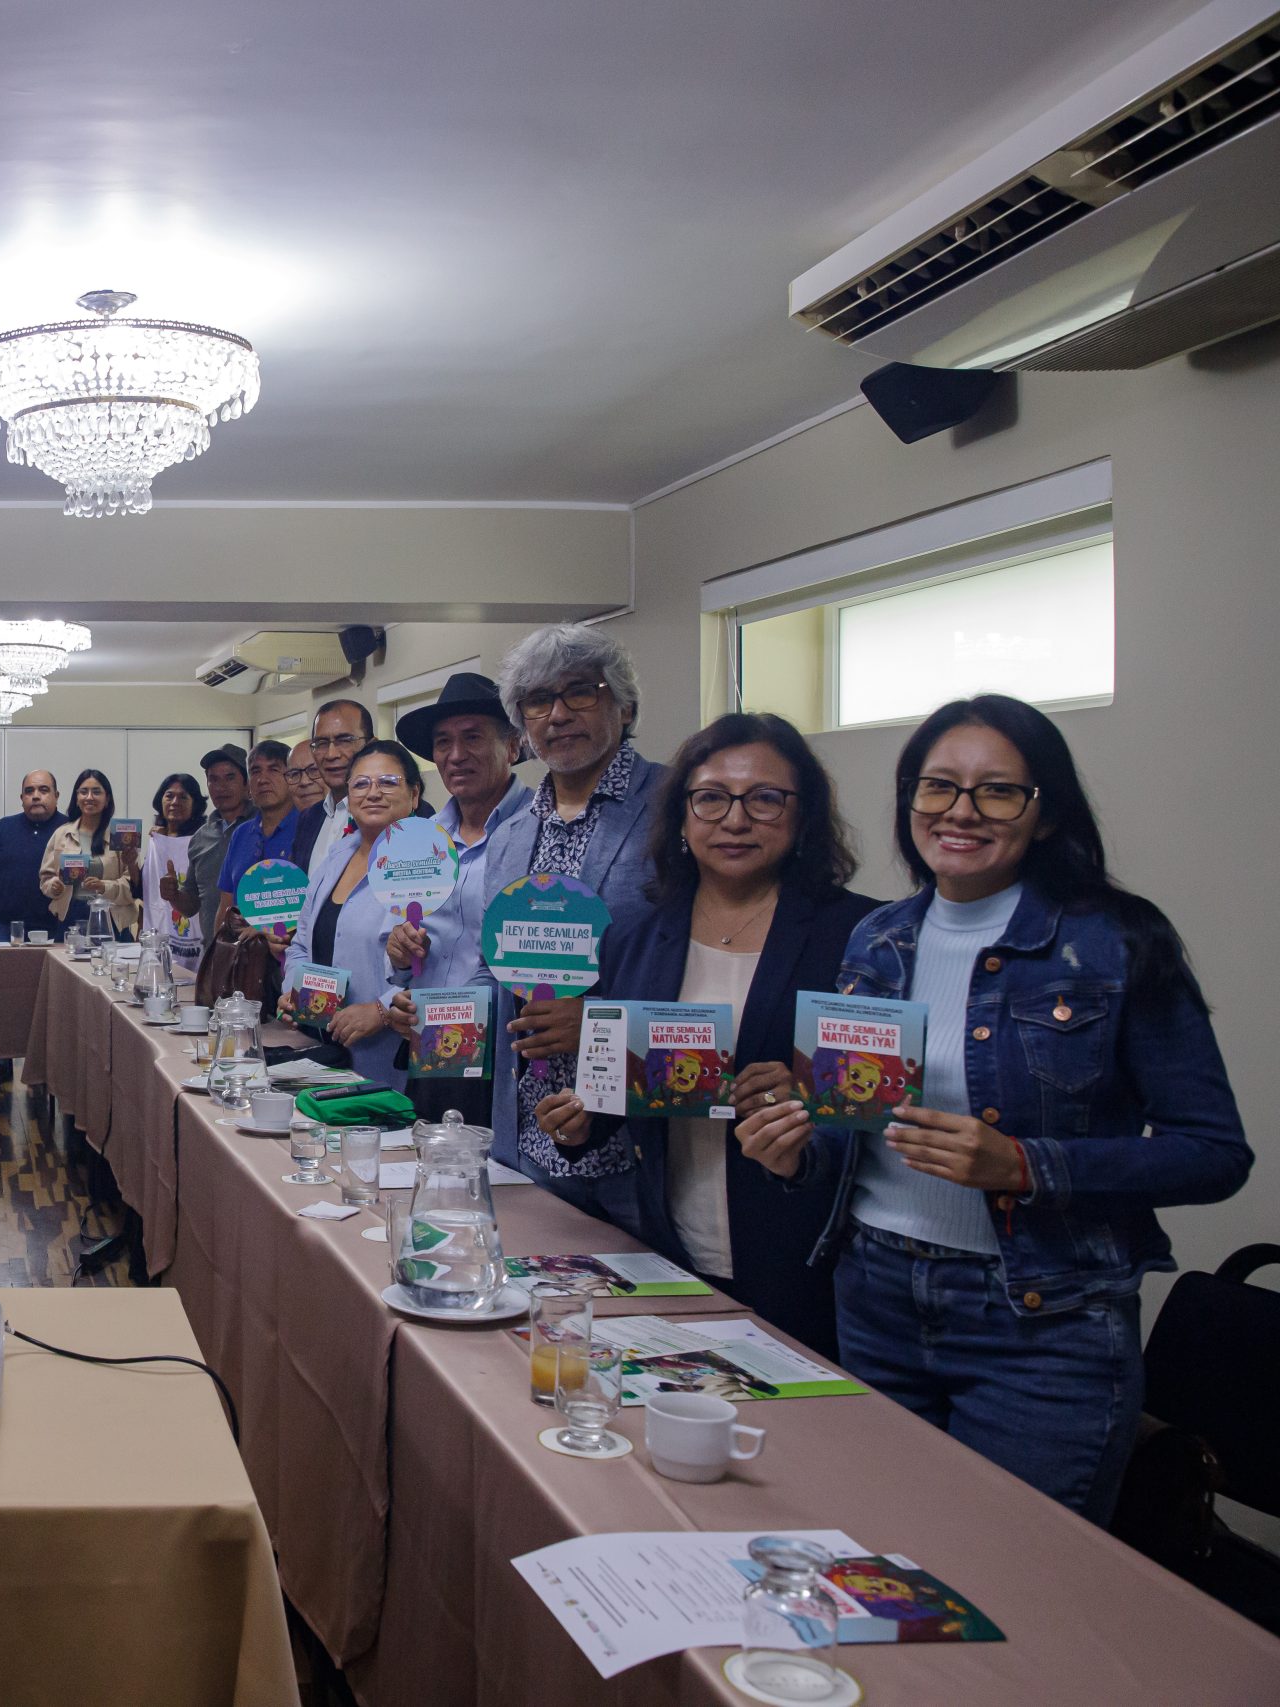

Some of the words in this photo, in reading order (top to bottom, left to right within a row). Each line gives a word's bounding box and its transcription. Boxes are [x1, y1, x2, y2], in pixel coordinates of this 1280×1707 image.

[505, 926, 524, 936] ¡LEY
[528, 927, 539, 936] DE
[544, 927, 589, 938] SEMILLAS
[519, 940, 556, 951] NATIVAS
[560, 942, 574, 951] YA!
[428, 1013, 456, 1021] NATIVAS
[821, 1022, 837, 1031] LEY
[840, 1024, 850, 1032] DE
[853, 1025, 896, 1036] SEMILLAS
[653, 1034, 690, 1043] NATIVAS
[692, 1035, 711, 1043] ¡YA!
[822, 1031, 869, 1046] NATIVAS
[872, 1037, 895, 1048] ¡YA!
